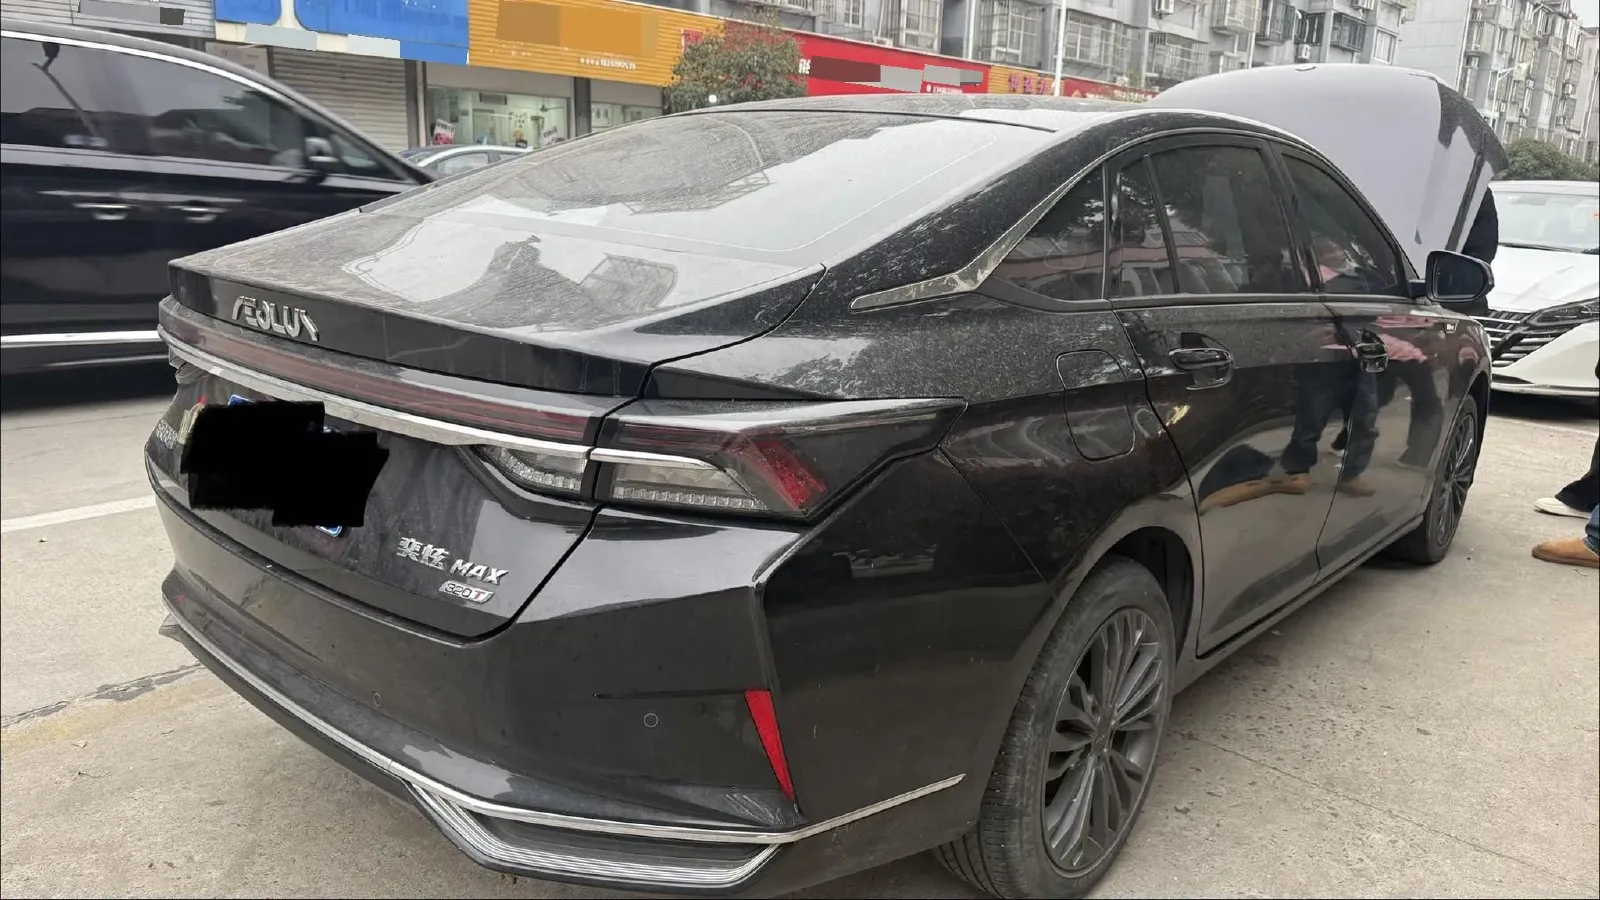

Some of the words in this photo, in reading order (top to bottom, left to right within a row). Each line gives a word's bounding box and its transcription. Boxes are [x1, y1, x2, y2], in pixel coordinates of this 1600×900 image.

[397, 536, 450, 571] 奕炫
[449, 558, 509, 585] MAX
[443, 582, 487, 601] 320T
